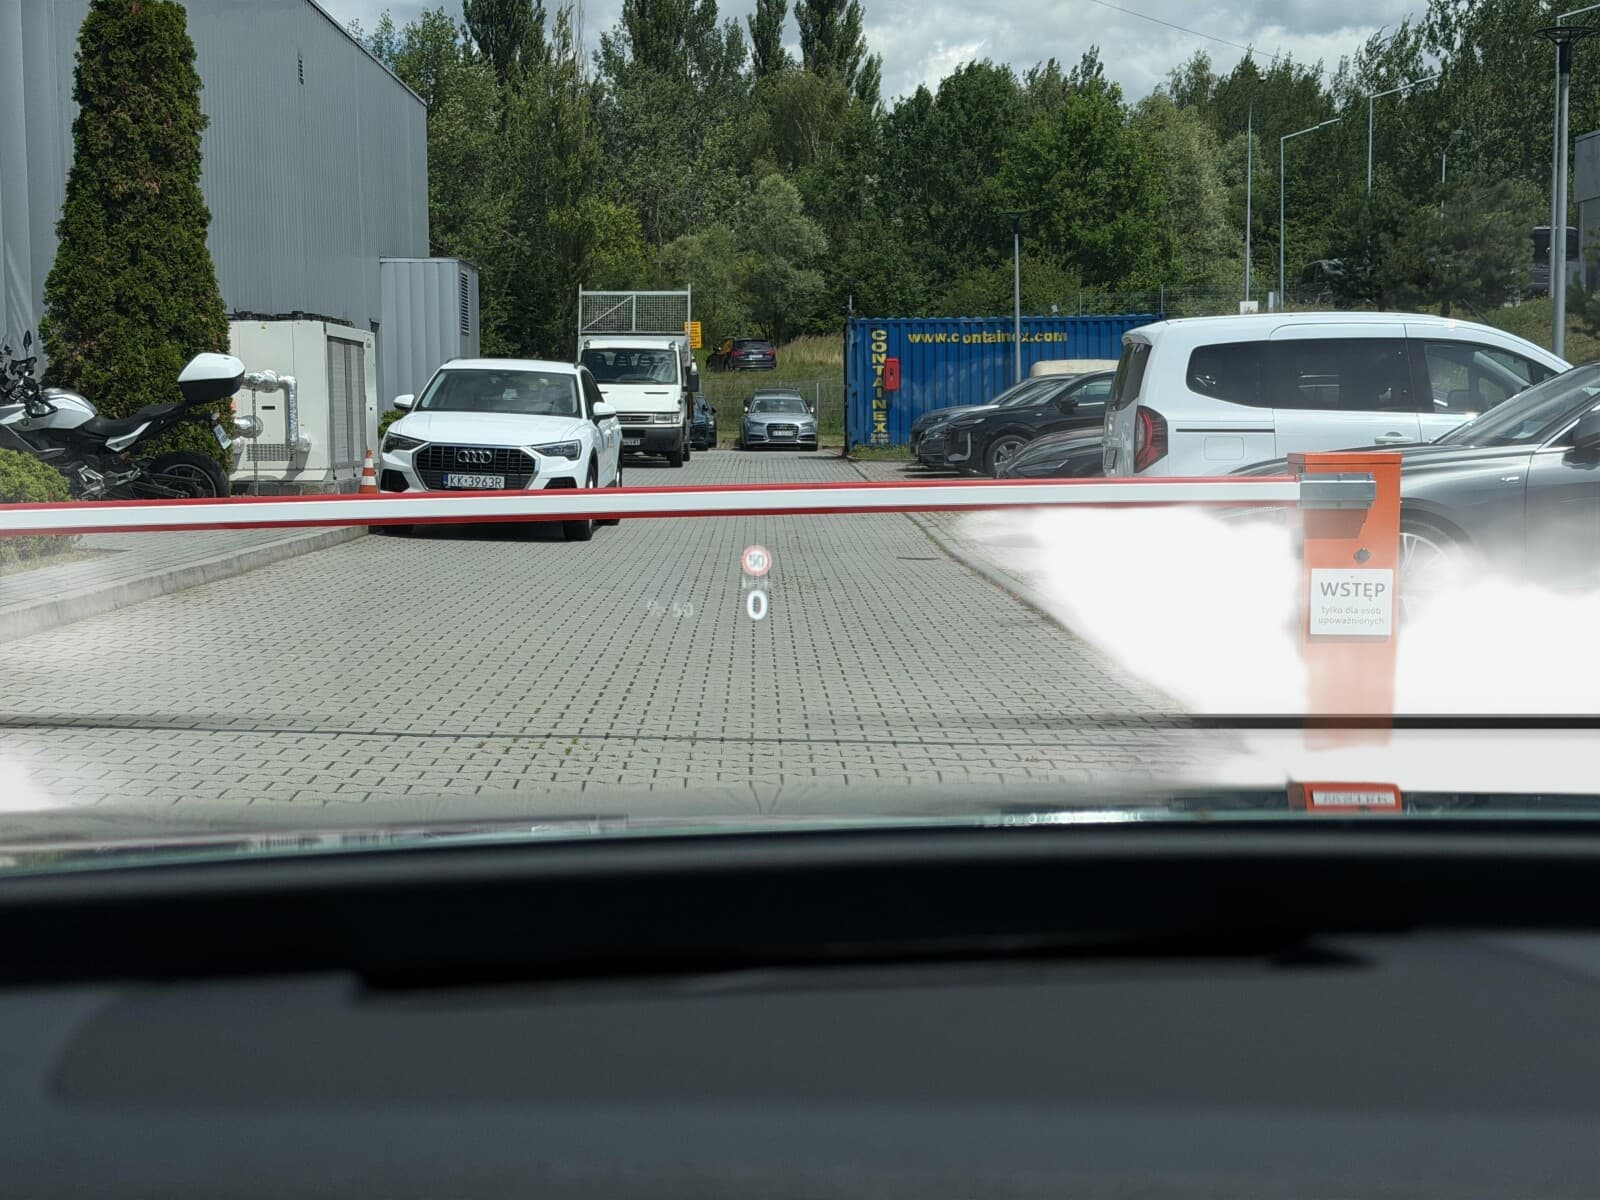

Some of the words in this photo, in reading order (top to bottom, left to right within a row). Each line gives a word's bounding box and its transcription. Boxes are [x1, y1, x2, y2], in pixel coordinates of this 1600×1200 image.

[1320, 582, 1385, 601] WSTĘP
[747, 590, 768, 620] 0
[1345, 606, 1359, 614] dla
